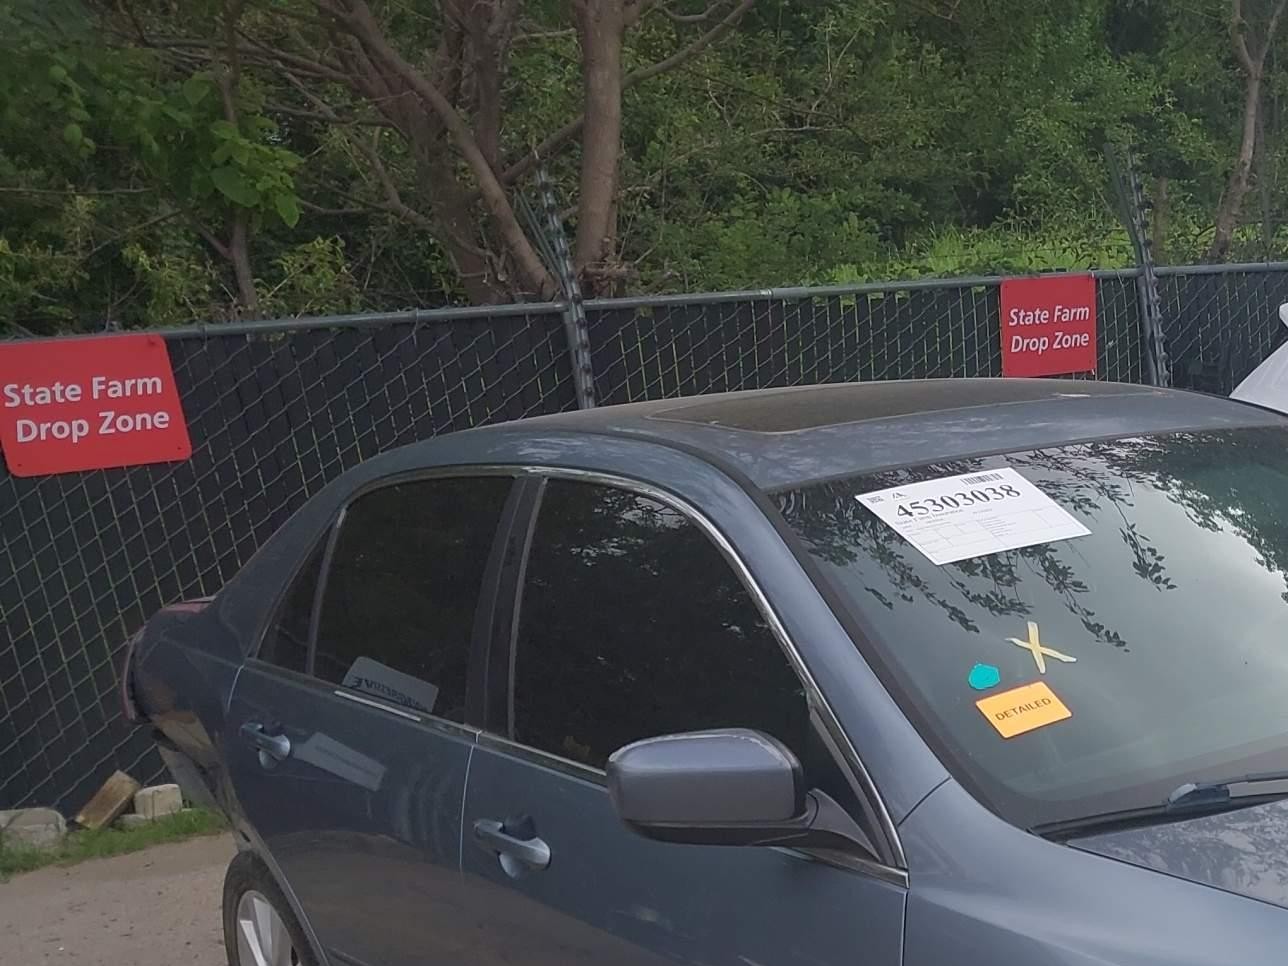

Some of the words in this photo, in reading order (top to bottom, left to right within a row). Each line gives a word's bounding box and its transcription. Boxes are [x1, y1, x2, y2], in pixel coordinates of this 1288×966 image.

[1008, 308, 1049, 327] State
[1053, 305, 1090, 322] Farm
[1011, 335, 1049, 355] Drop
[1053, 331, 1089, 349] Zone
[3, 382, 82, 408] State
[92, 376, 162, 399] Farm
[16, 418, 89, 443] Drop
[98, 410, 170, 434] Zone
[897, 484, 1021, 518] 45303038
[995, 698, 1052, 721] DETAILED
